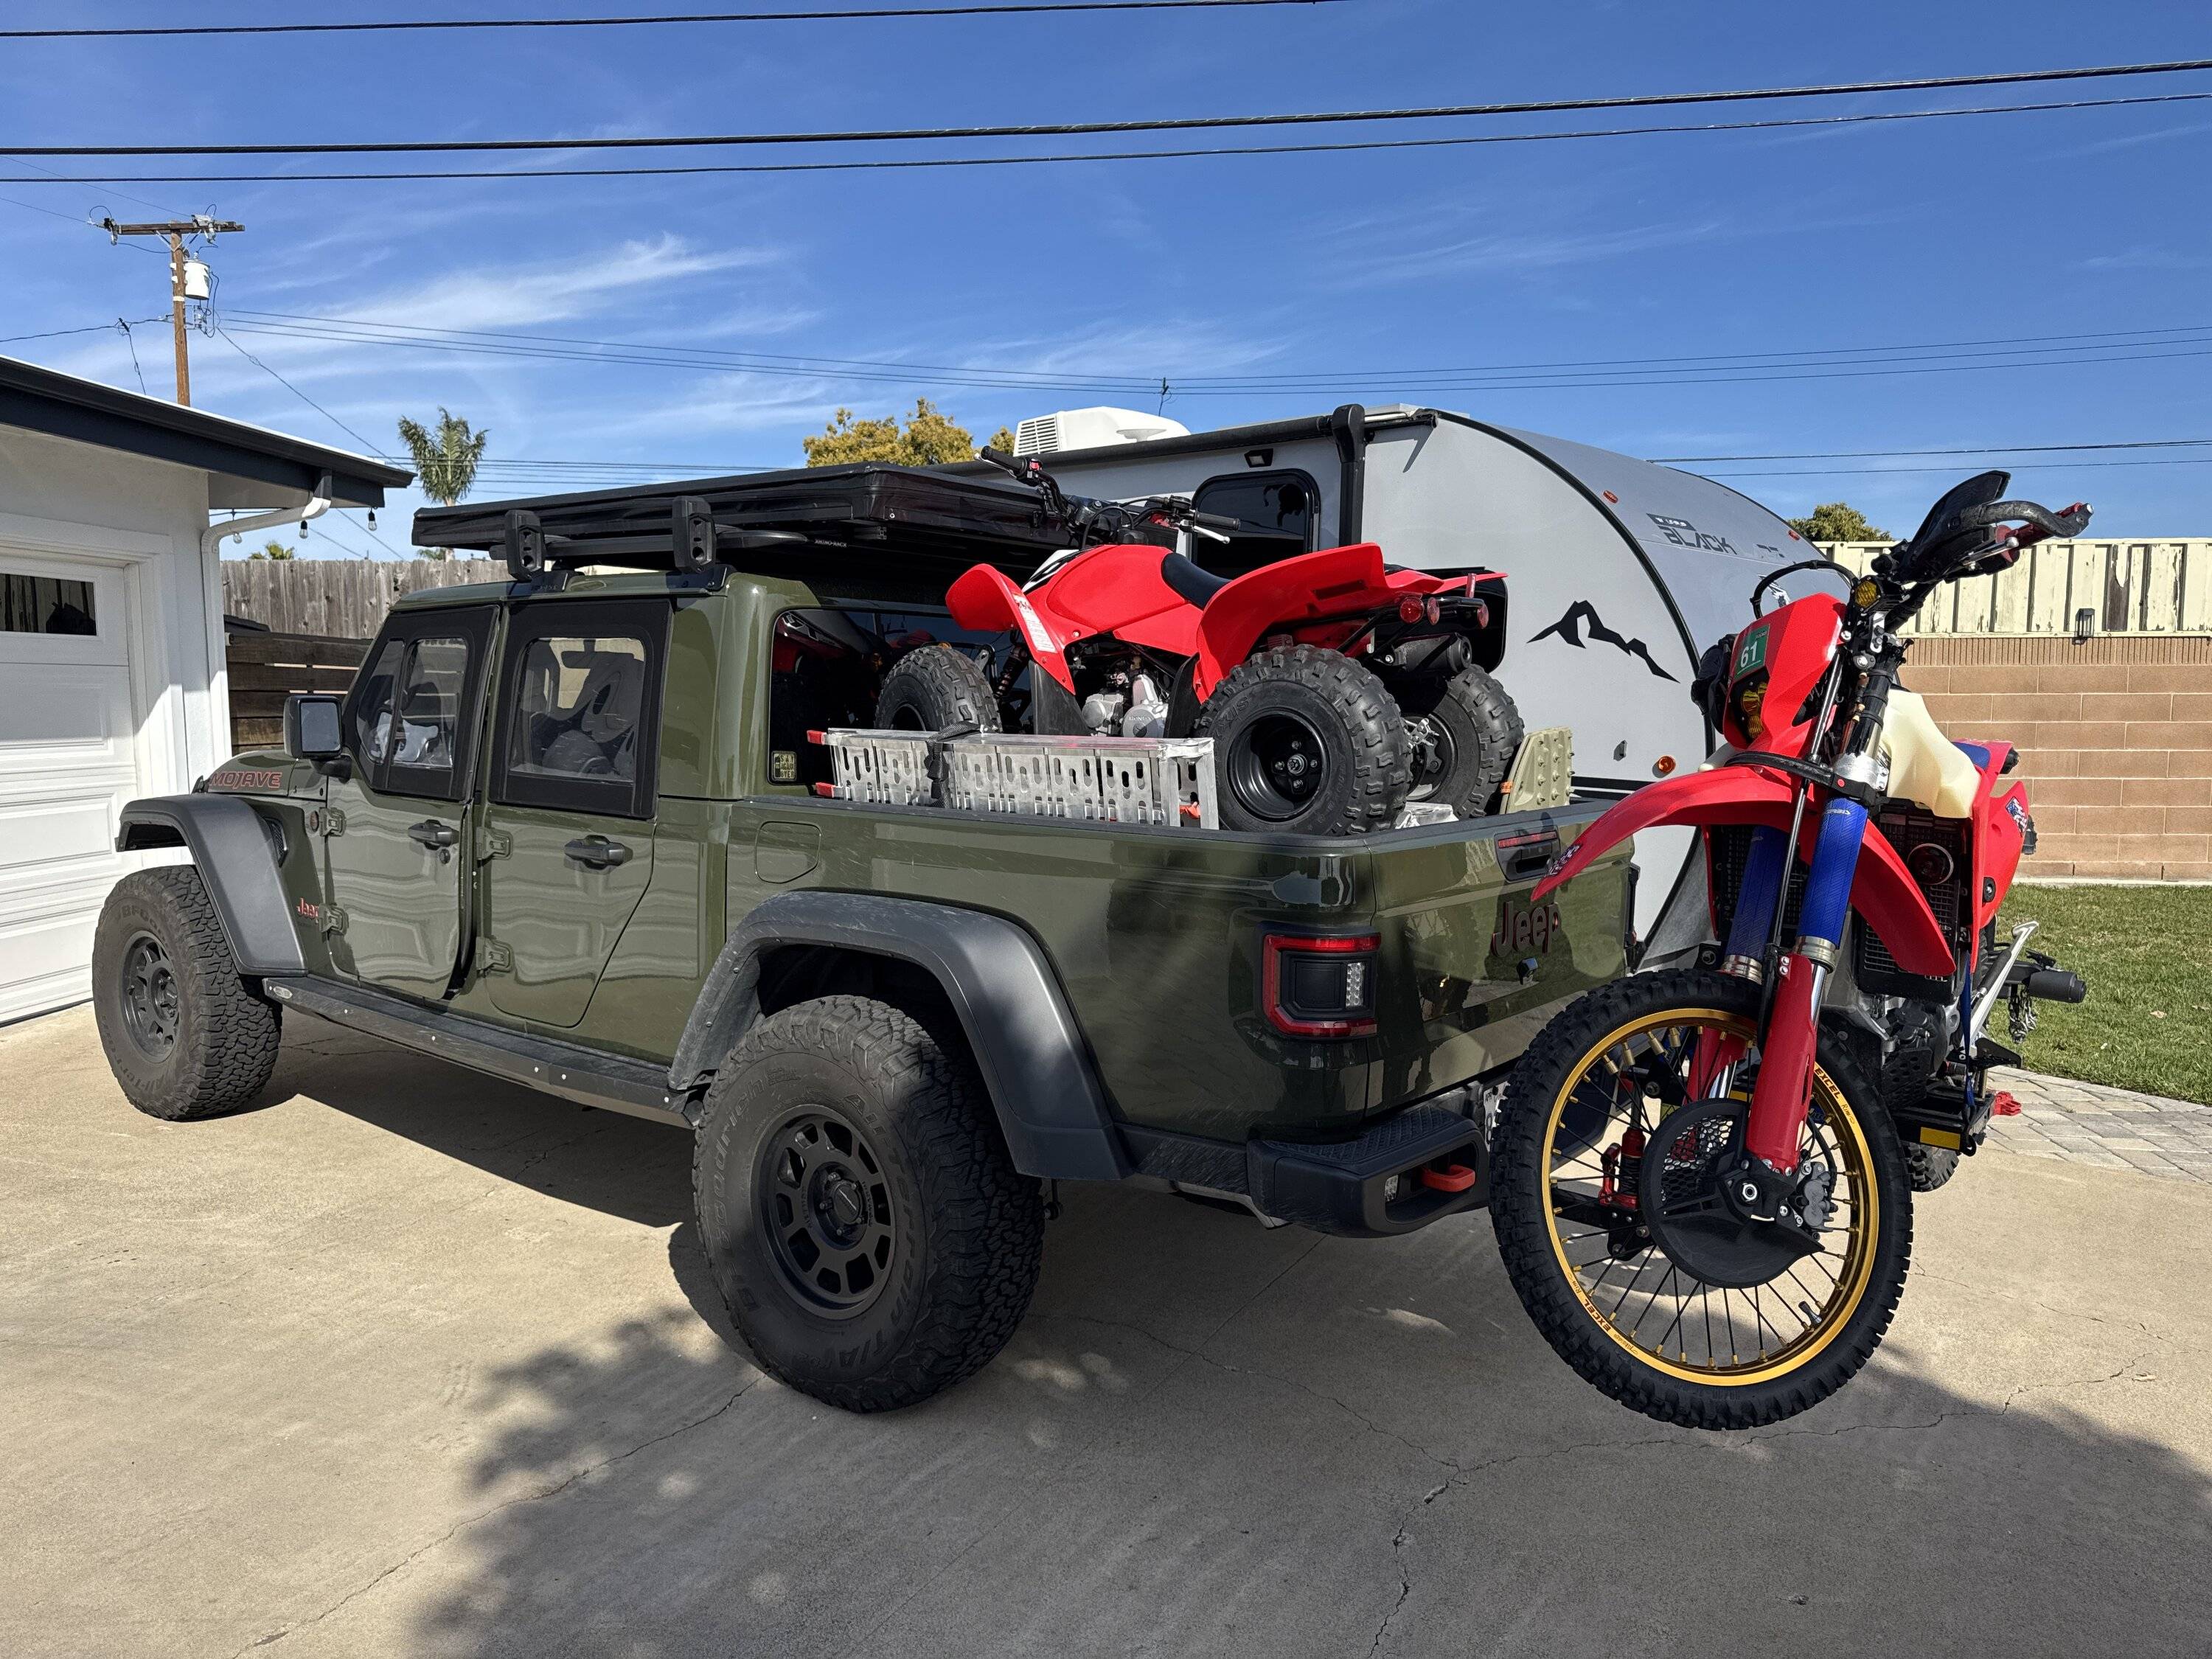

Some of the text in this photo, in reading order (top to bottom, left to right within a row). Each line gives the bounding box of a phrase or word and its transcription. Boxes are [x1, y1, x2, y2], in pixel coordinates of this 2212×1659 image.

[1658, 524, 1737, 555] BLACK
[1741, 641, 1758, 668] 61
[780, 754, 794, 762] SAY
[209, 770, 282, 790] MOJAVE
[1491, 900, 1562, 957] Jeep
[1815, 1068, 1840, 1099] EXCEL
[1582, 1298, 1613, 1332] EXCEL
